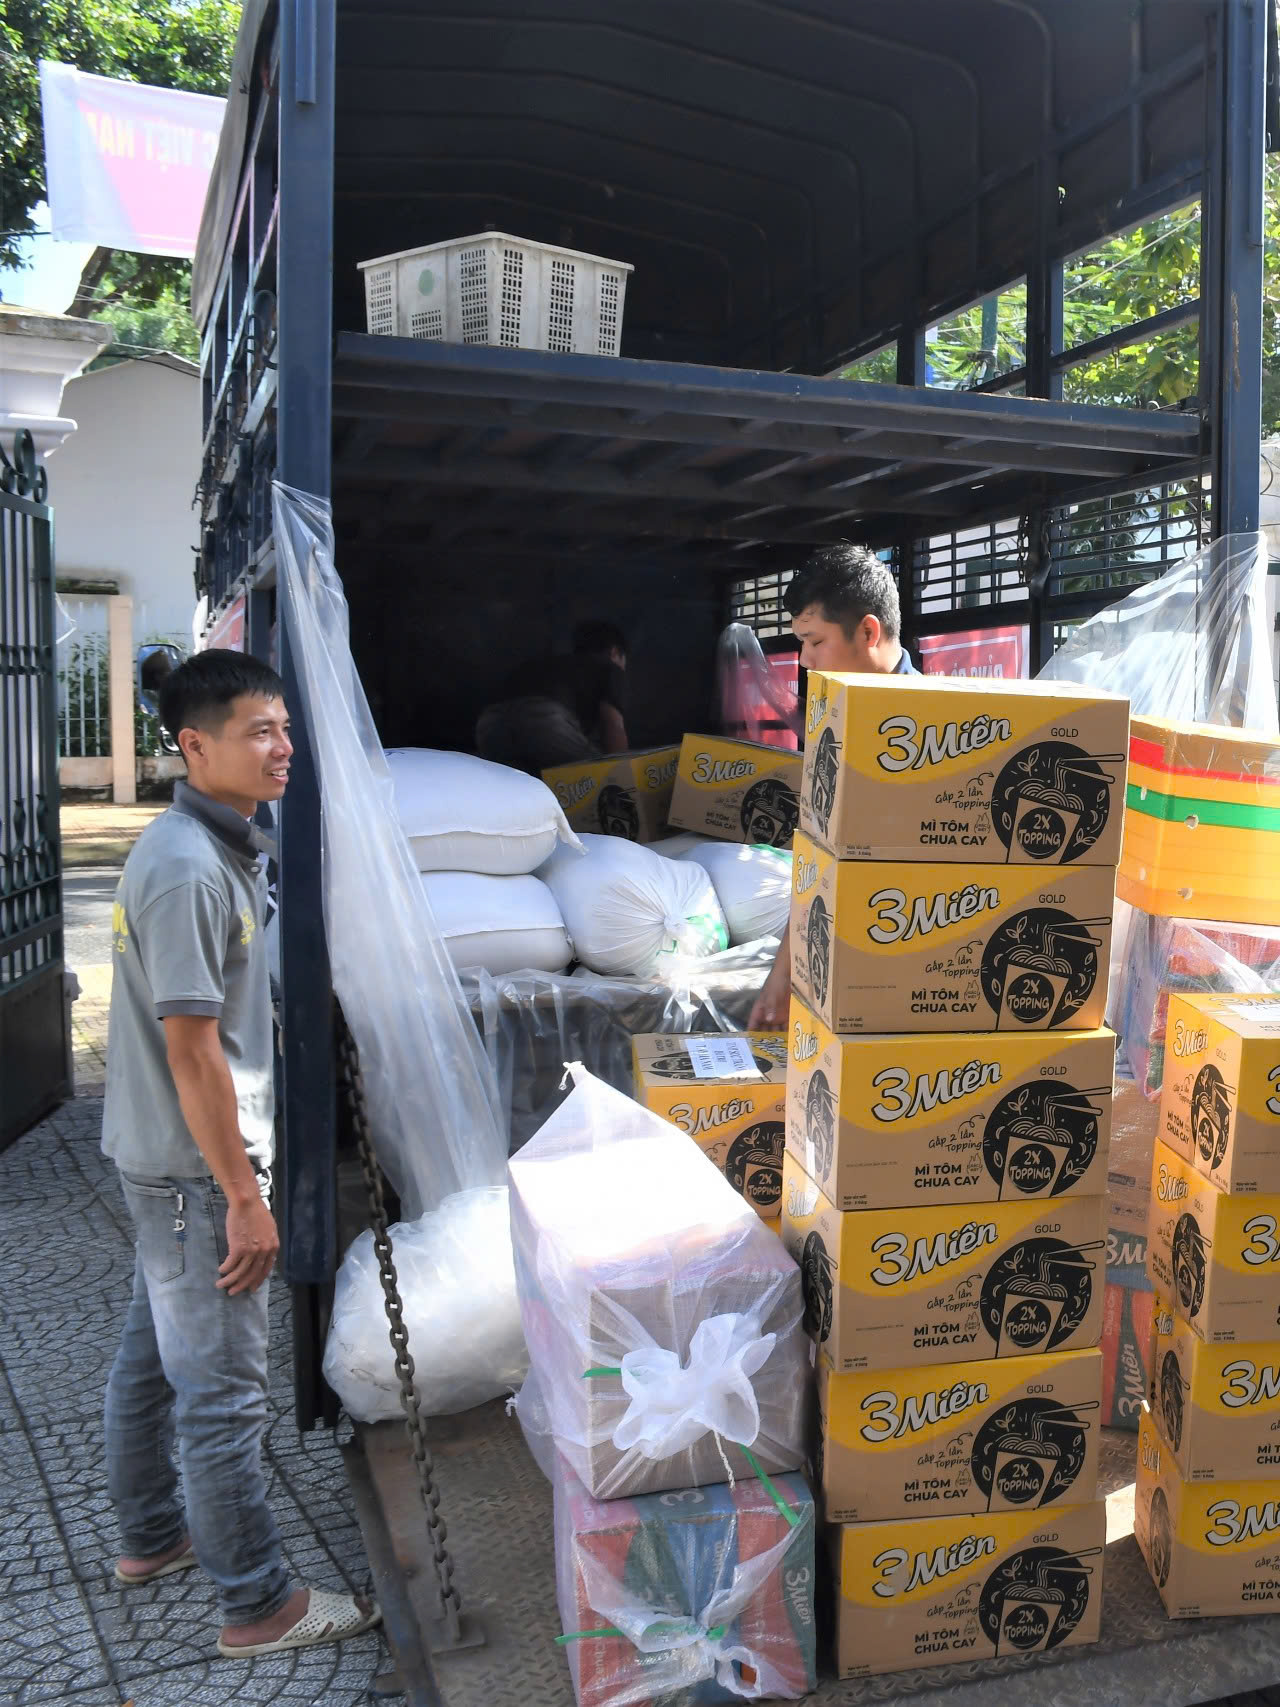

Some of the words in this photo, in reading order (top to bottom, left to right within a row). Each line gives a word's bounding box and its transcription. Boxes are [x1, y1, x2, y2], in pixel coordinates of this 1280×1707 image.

[1051, 728, 1078, 737] GOLD
[953, 798, 990, 810] Topping
[921, 818, 936, 832] MÌ
[940, 820, 969, 832] TÔM
[1033, 814, 1052, 830] 2X
[919, 835, 957, 845] CHUA
[961, 835, 988, 846] CAY
[1018, 830, 1061, 846] TOPPING
[1039, 894, 1065, 903] GOLD
[911, 987, 926, 1001] MÌ
[930, 988, 959, 1000] TÔM
[910, 1003, 948, 1014] CHUA
[951, 1003, 977, 1013] CAY
[1040, 1066, 1066, 1076] GOLD
[1024, 1150, 1042, 1166] 2X
[915, 1163, 930, 1176] MÌ
[934, 1163, 962, 1175] TÔM
[1009, 1167, 1051, 1180] TOPPING
[757, 1172, 772, 1185] 2X
[914, 1177, 951, 1189] CHUA
[954, 1176, 980, 1186] CAY
[746, 1185, 781, 1197] TOPPING
[1035, 1223, 1061, 1234] GOLD
[914, 1323, 929, 1337] MÌ
[932, 1322, 960, 1335] TÔM
[913, 1336, 949, 1349] CHUA
[952, 1333, 977, 1344] CAY
[1027, 1384, 1054, 1394] GOLD
[1257, 1443, 1271, 1454] MÌ
[904, 1479, 919, 1491] MÌ
[923, 1478, 951, 1490] TÔM
[903, 1491, 940, 1503] CHUA
[943, 1489, 969, 1499] CAY
[1032, 1532, 1058, 1543] GOLD
[915, 1631, 929, 1643] MÌ
[932, 1628, 959, 1641] TÔM
[914, 1641, 949, 1655] CHUA
[952, 1637, 976, 1649] CAY
